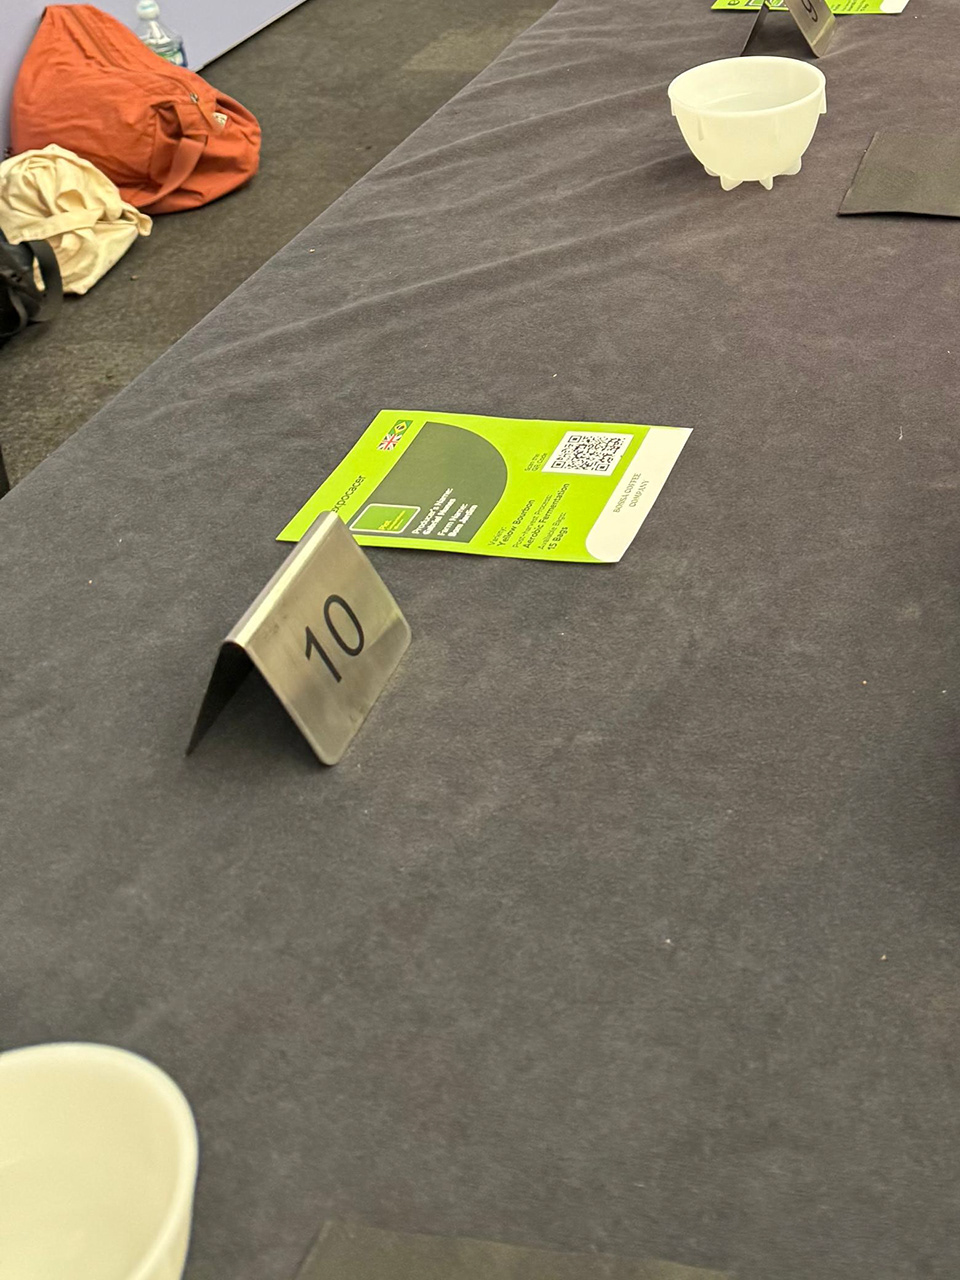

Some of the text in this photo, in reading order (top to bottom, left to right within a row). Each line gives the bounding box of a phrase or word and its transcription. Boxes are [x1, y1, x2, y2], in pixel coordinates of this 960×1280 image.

[411, 487, 454, 534] Producer's Name:
[612, 473, 642, 512] BOSSA COFFEE
[628, 480, 650, 507] COMPANY
[437, 503, 469, 535] Farm Name:
[496, 499, 535, 547] Yellow Bourbon
[522, 483, 570, 548] Aerobic Fermentation
[553, 526, 569, 542] Bags
[305, 594, 364, 683] 10
